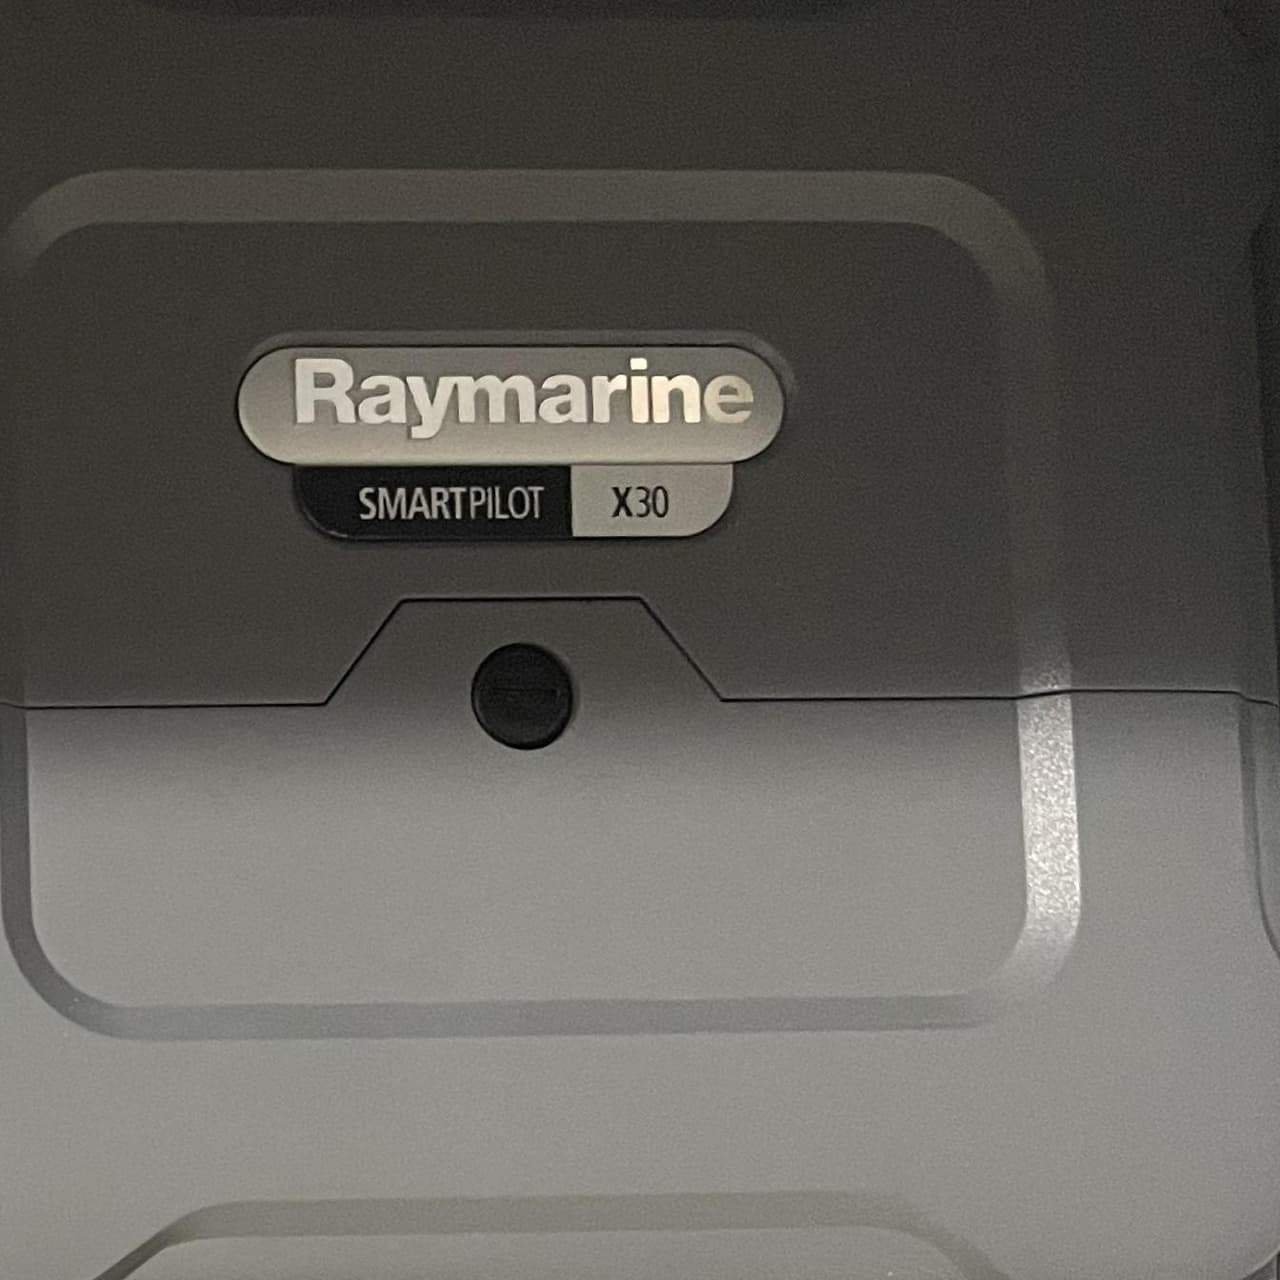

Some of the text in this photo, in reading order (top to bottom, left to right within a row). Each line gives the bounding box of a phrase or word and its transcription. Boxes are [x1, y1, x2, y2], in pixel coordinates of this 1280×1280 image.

[294, 358, 754, 438] Raymarine
[359, 486, 669, 520] SMARTPILOT X30
